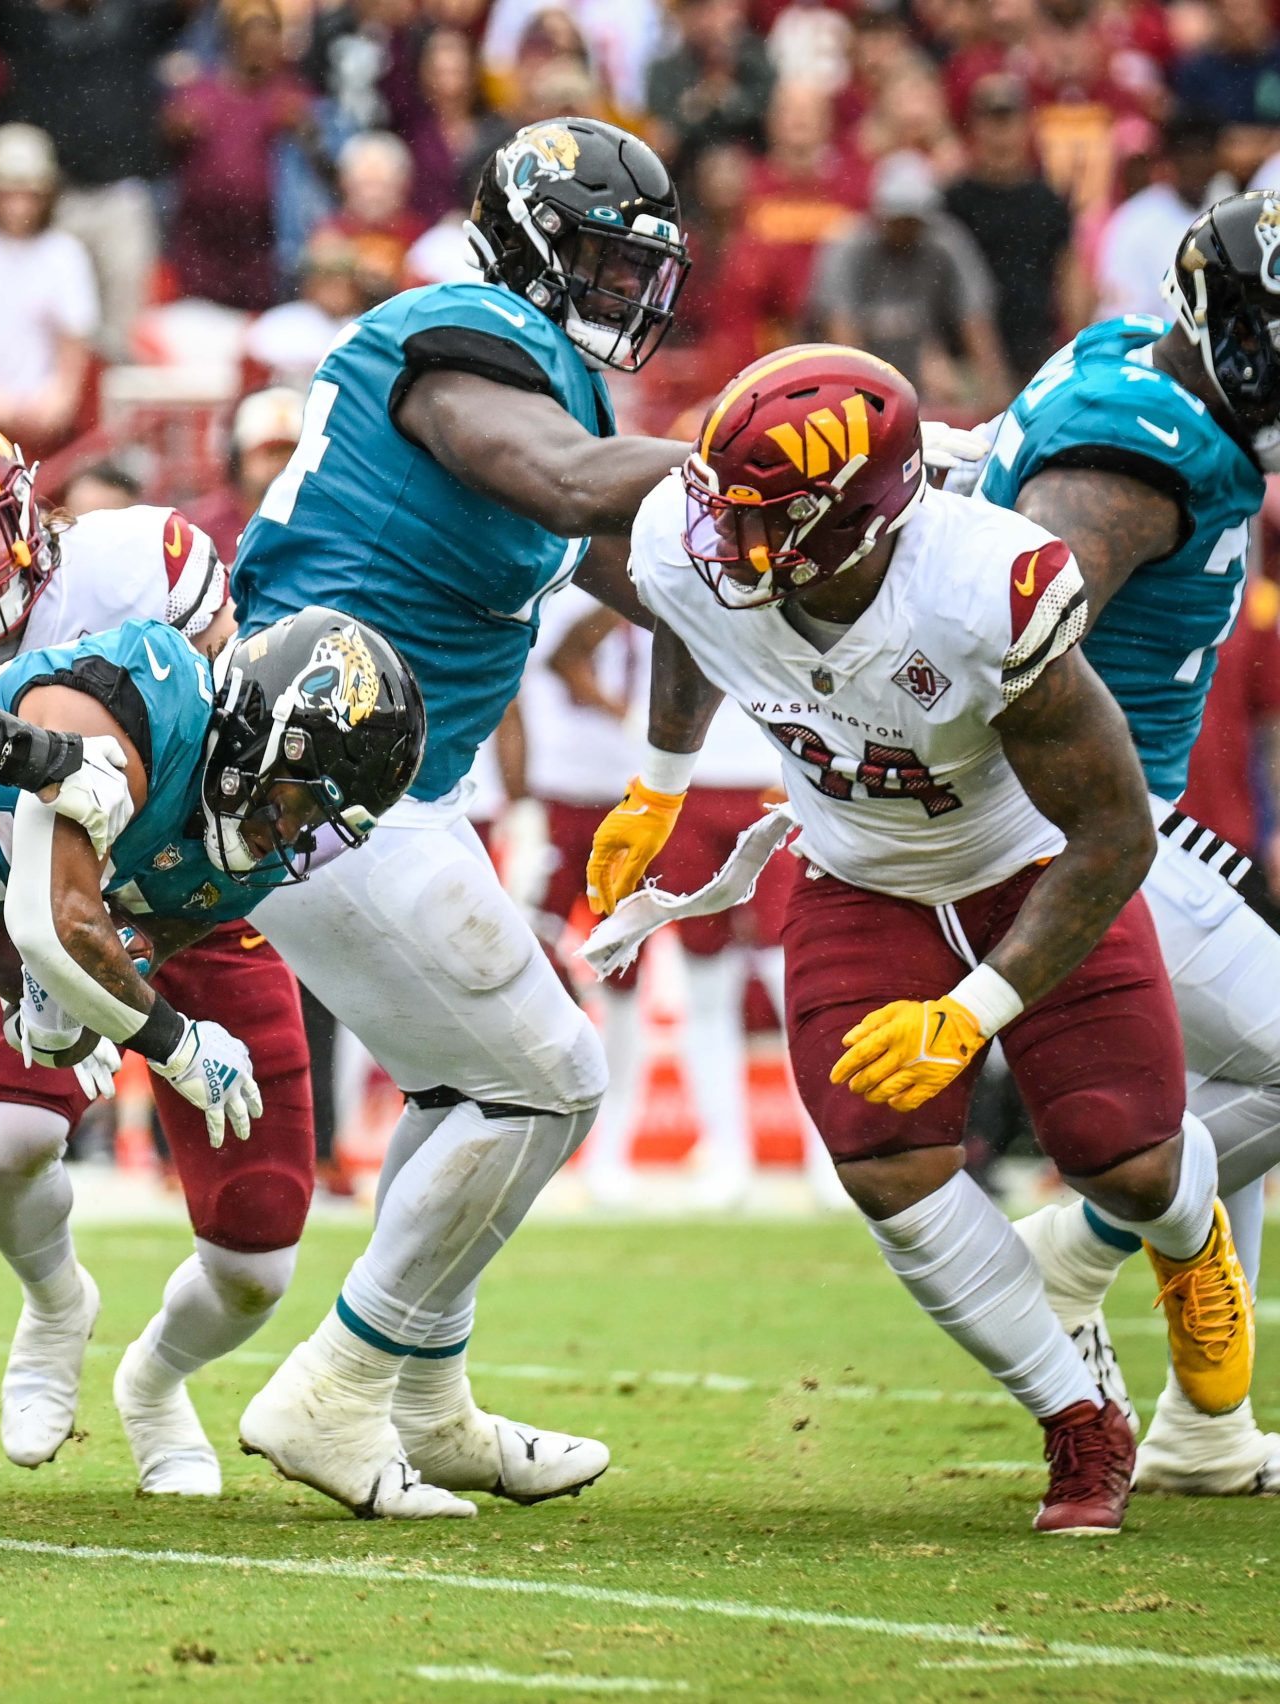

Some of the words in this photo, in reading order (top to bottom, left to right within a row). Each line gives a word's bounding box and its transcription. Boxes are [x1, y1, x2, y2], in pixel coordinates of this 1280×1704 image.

[907, 665, 937, 697] 90
[750, 701, 904, 739] WASHNGTON
[24, 967, 44, 1013] didas
[202, 1058, 221, 1105] adidas
